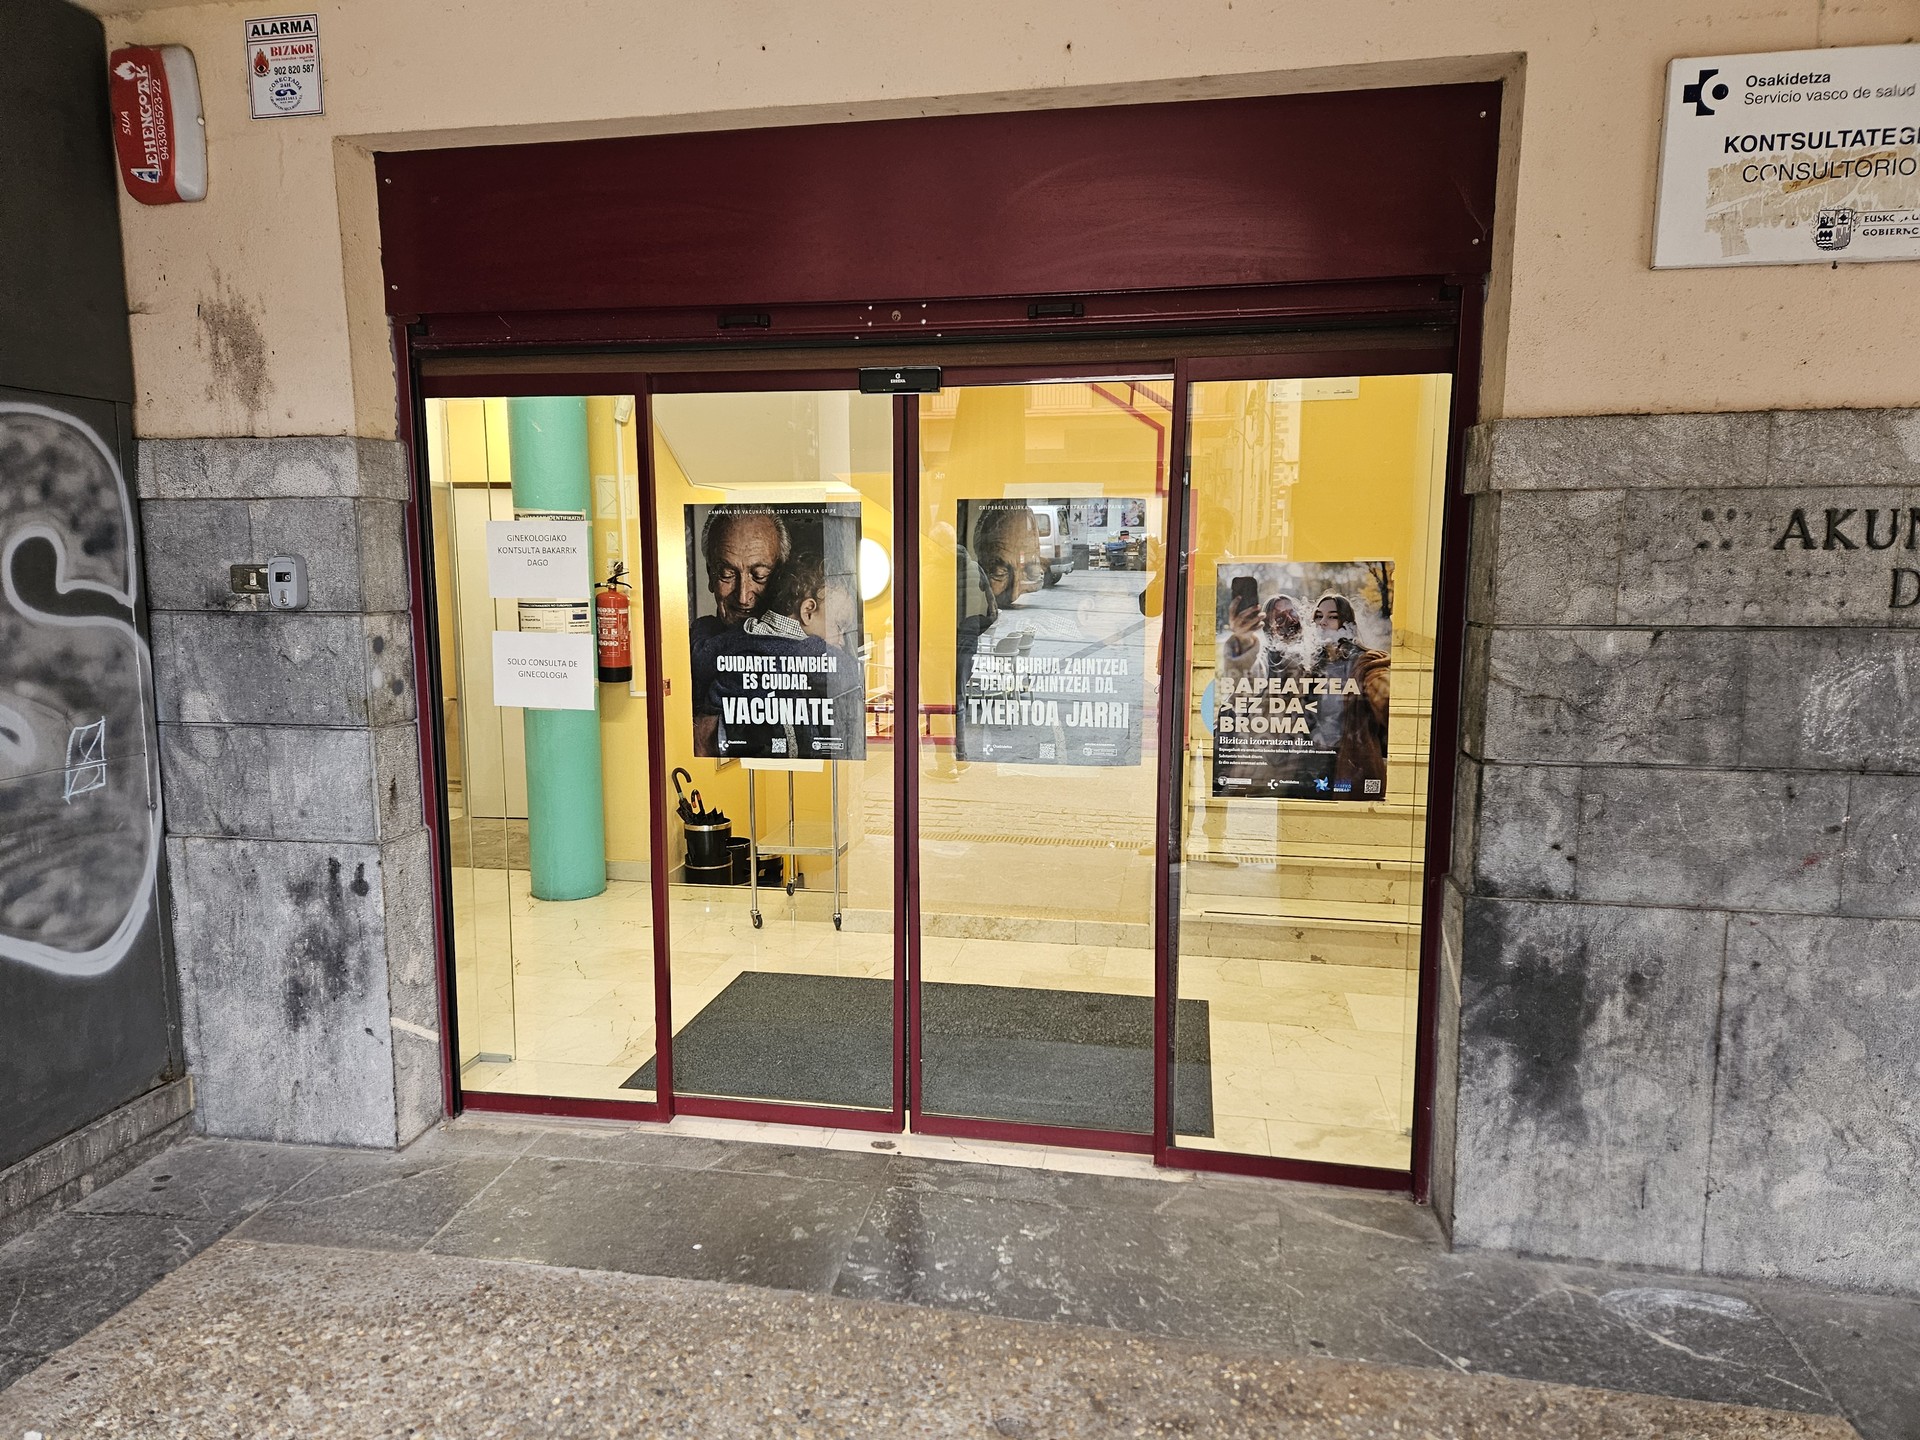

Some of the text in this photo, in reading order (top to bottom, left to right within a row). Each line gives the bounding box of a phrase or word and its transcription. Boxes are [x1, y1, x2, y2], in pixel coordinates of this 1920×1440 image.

[251, 20, 313, 36] ALARMA
[270, 44, 314, 57] BIZKOR
[274, 67, 287, 76] 902
[288, 65, 301, 75] 820
[302, 64, 315, 73] 587
[269, 76, 303, 92] CONECTADA
[1746, 72, 1831, 88] Osakidetza
[1744, 83, 1917, 105] Servicio vasco de salud
[120, 110, 132, 136] SUA
[131, 64, 161, 179] LEHENGOAK
[152, 78, 169, 160] 943305523-22
[1742, 157, 1917, 183] CONSULTORIO
[506, 534, 567, 542] GINEKOLOGIAKO
[497, 546, 577, 555] KONTSULTA BAKARRIK
[527, 559, 549, 567] DAGO
[507, 657, 578, 668] SOLO CONSULTA DE
[716, 653, 837, 673] CUIDARTE TAMBIÉN
[971, 656, 1129, 676] ZEURE BURUA ZAINTZEA
[518, 670, 568, 679] GINECOLOGIA
[742, 673, 812, 690] ES CUIDAR.
[980, 675, 1118, 694] DENOK ZAINTZEA DA.
[1220, 677, 1361, 695] BAPEATZEA
[722, 691, 835, 726] VACÚNATE
[968, 698, 1130, 729] TXERTOA JARRI
[1219, 716, 1310, 734] BROMA
[1219, 736, 1314, 747] Bizitza izorratzen dizu
